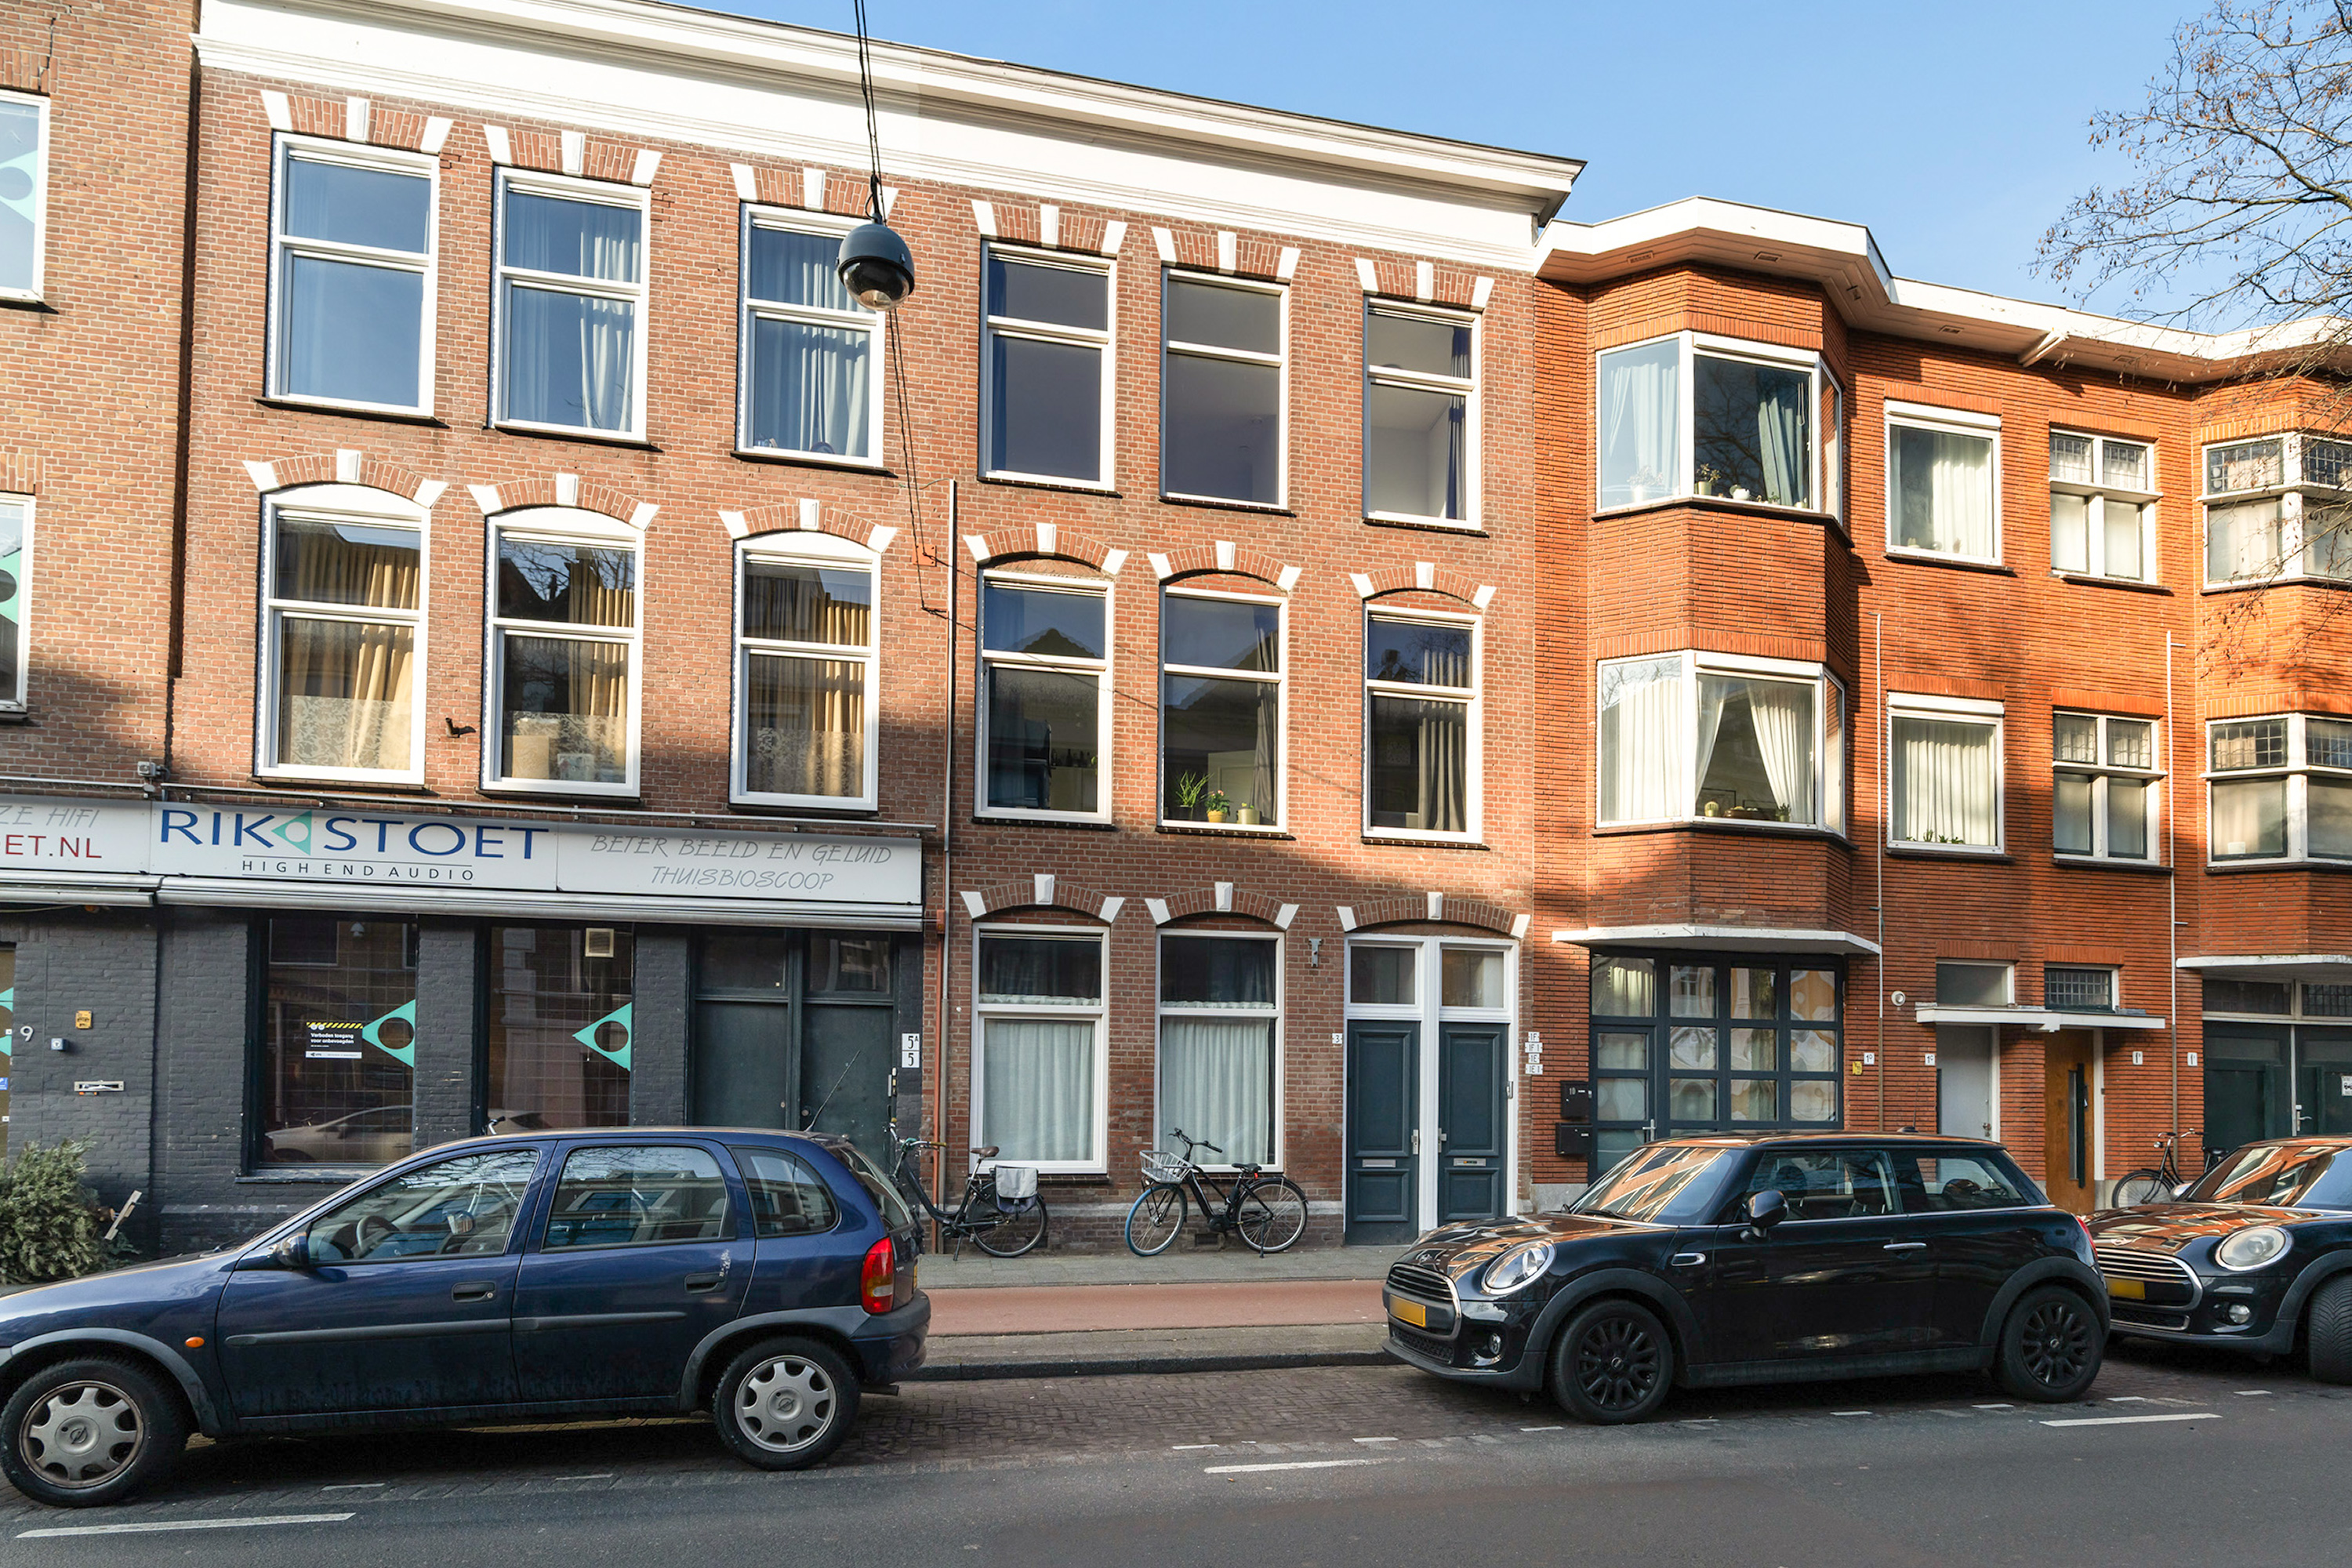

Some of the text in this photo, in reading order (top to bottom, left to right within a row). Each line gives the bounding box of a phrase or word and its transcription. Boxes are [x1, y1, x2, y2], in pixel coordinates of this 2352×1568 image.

[45, 808, 100, 828] HIFI
[0, 833, 103, 858] ET.NL
[161, 809, 549, 860] RIK STOET
[590, 835, 892, 866] BETER BEELD EN GELUID
[388, 866, 474, 881] AUDIO
[651, 866, 834, 890] THUISBIOSCOOP
[20, 1025, 34, 1042] 9
[907, 1052, 914, 1067] 5
